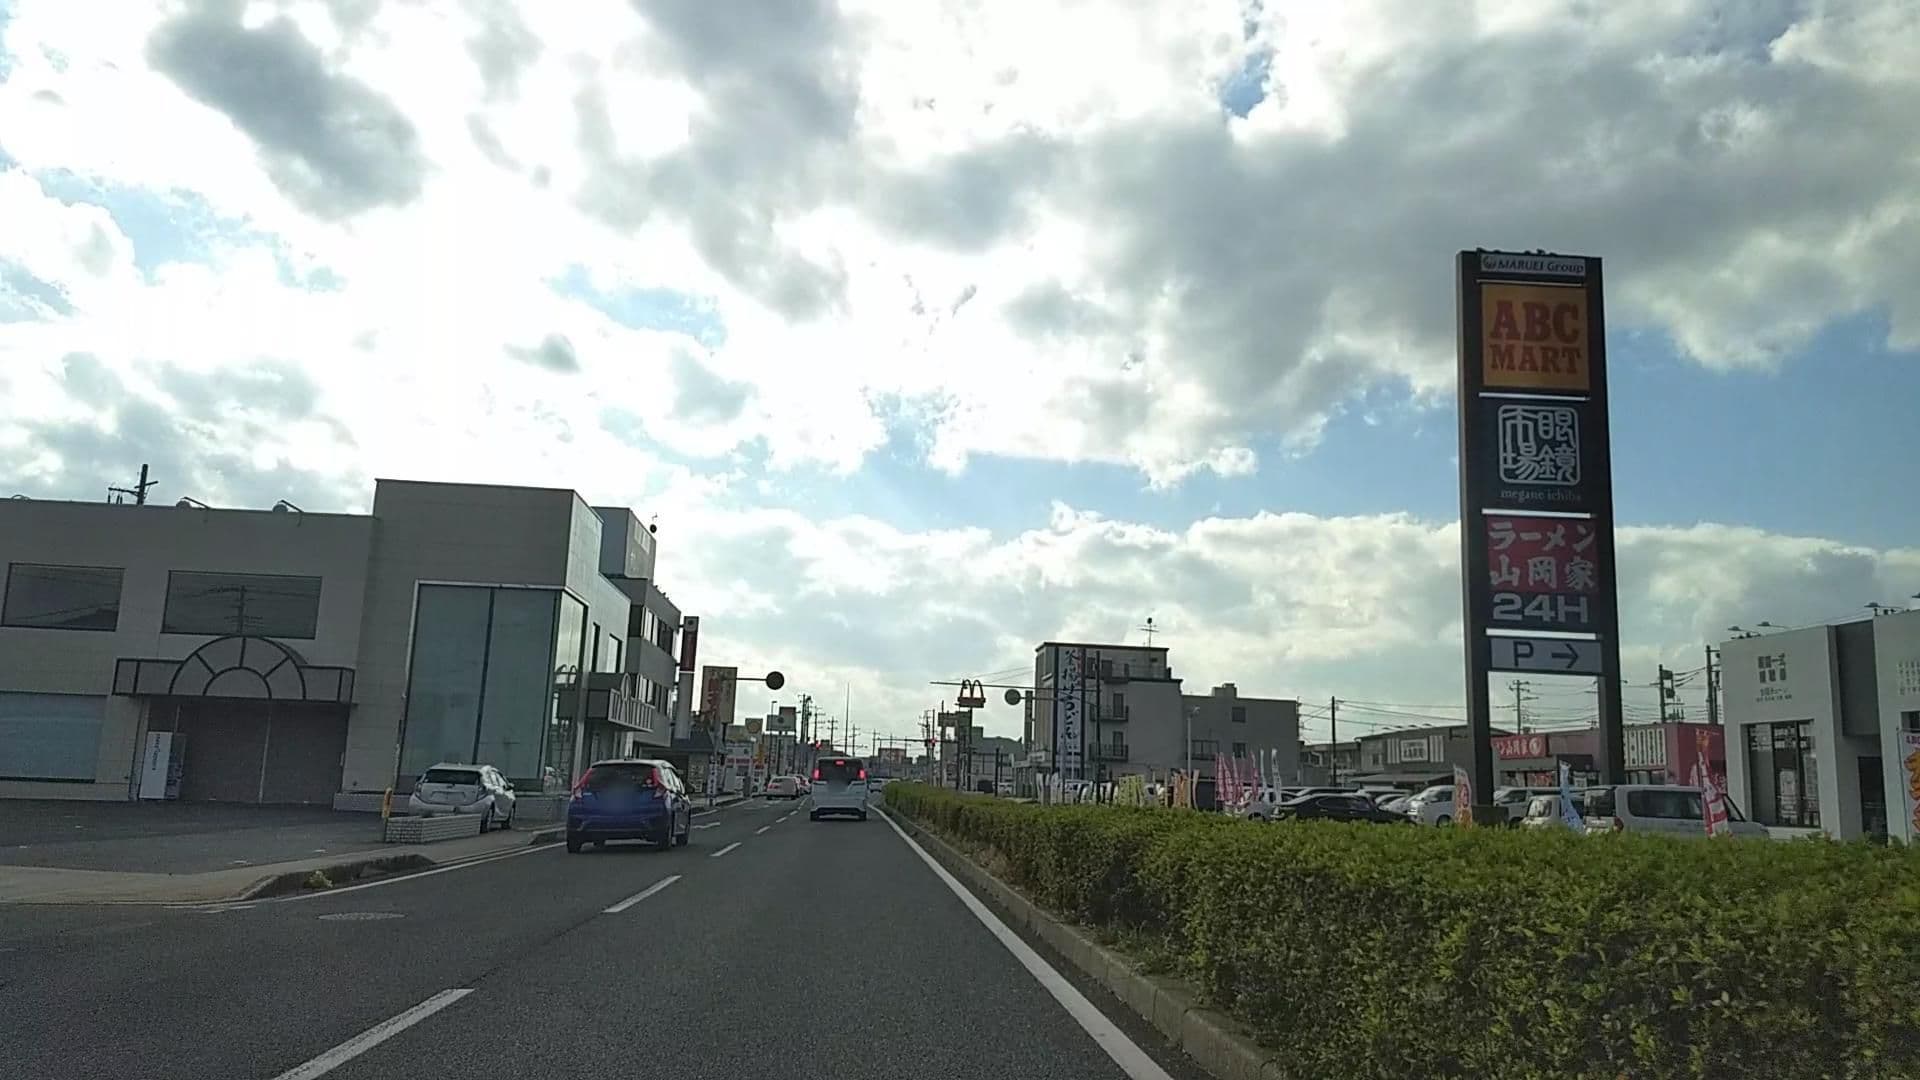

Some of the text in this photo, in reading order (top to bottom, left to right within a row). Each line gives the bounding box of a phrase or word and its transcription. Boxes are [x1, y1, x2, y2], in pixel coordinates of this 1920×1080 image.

[1497, 259, 1584, 274] MARUEI Group
[1490, 301, 1580, 343] ABC
[1489, 344, 1582, 374] MART
[1500, 490, 1545, 503] megane
[1489, 521, 1595, 552] ラーメン
[1488, 553, 1595, 592] 山岡家
[1492, 592, 1589, 624] 24H
[1514, 641, 1535, 668] P
